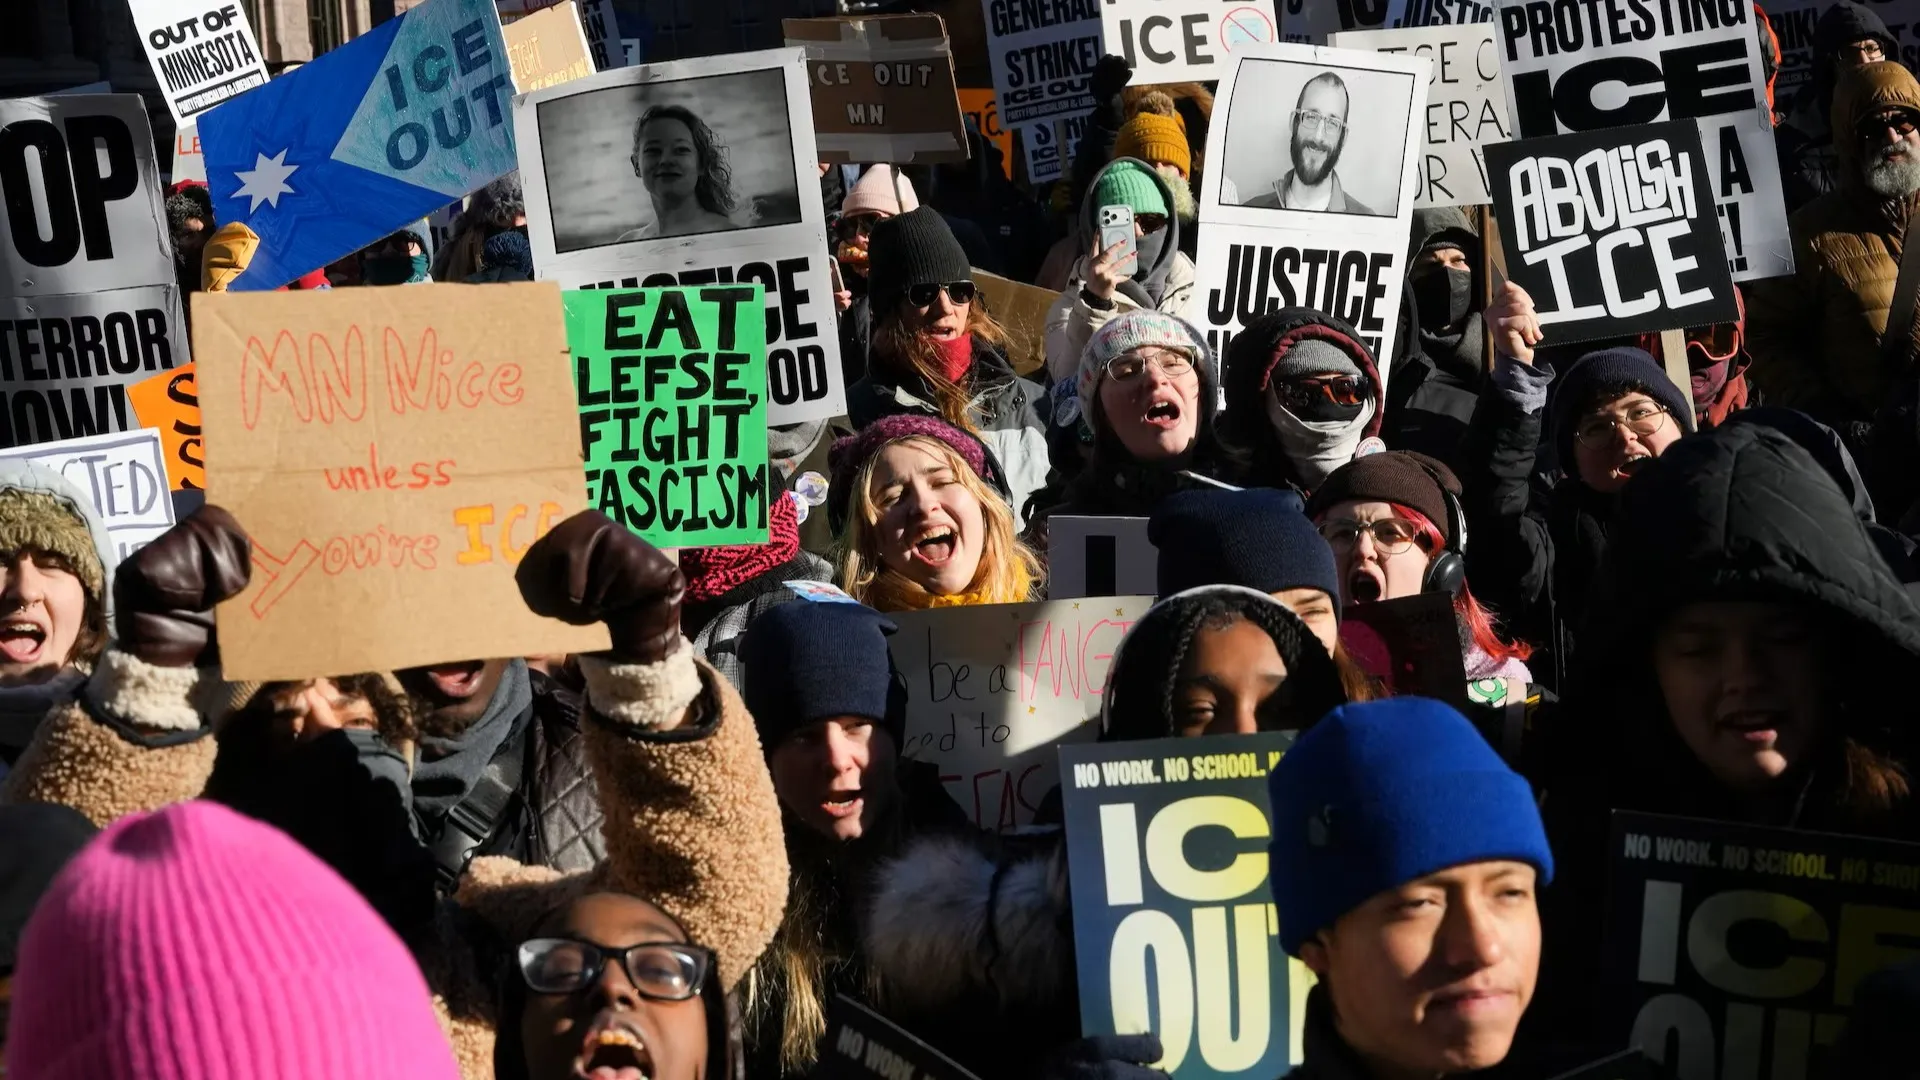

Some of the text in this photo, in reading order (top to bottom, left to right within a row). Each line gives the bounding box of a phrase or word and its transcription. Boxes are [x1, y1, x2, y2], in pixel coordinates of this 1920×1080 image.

[149, 4, 238, 50] OUT OF
[1120, 13, 1214, 69] ICE
[1501, 0, 1747, 61] PROTESTING
[157, 29, 256, 93] MINNESOTA
[385, 18, 493, 113] ICE
[808, 62, 932, 88] CE OUT
[1512, 38, 1757, 138] ICE
[386, 73, 507, 171] OUT
[847, 103, 885, 126] MN
[1003, 85, 1044, 106] ICE
[0, 115, 139, 268] OP
[1207, 244, 1394, 332] JUSTICE
[1523, 219, 1714, 326] ICE
[605, 288, 755, 350] EAT
[240, 324, 368, 431] MN
[383, 326, 525, 415] Nice
[577, 353, 759, 409] LEFSE,
[580, 404, 751, 465] FIGHT
[324, 442, 457, 492] unless
[928, 626, 977, 703] be
[989, 663, 1016, 693] a
[974, 711, 1011, 748] to
[1074, 764, 1100, 788] NO
[1102, 759, 1161, 786] WORK.
[1164, 756, 1190, 783] NO
[1192, 753, 1266, 780] SCHOOL.
[1624, 833, 1651, 859] NO
[1656, 836, 1717, 866] WORK.
[1722, 844, 1748, 871] NO
[1753, 848, 1835, 881] SCHOOL.
[1840, 857, 1868, 884] NO
[836, 1023, 864, 1061] NO
